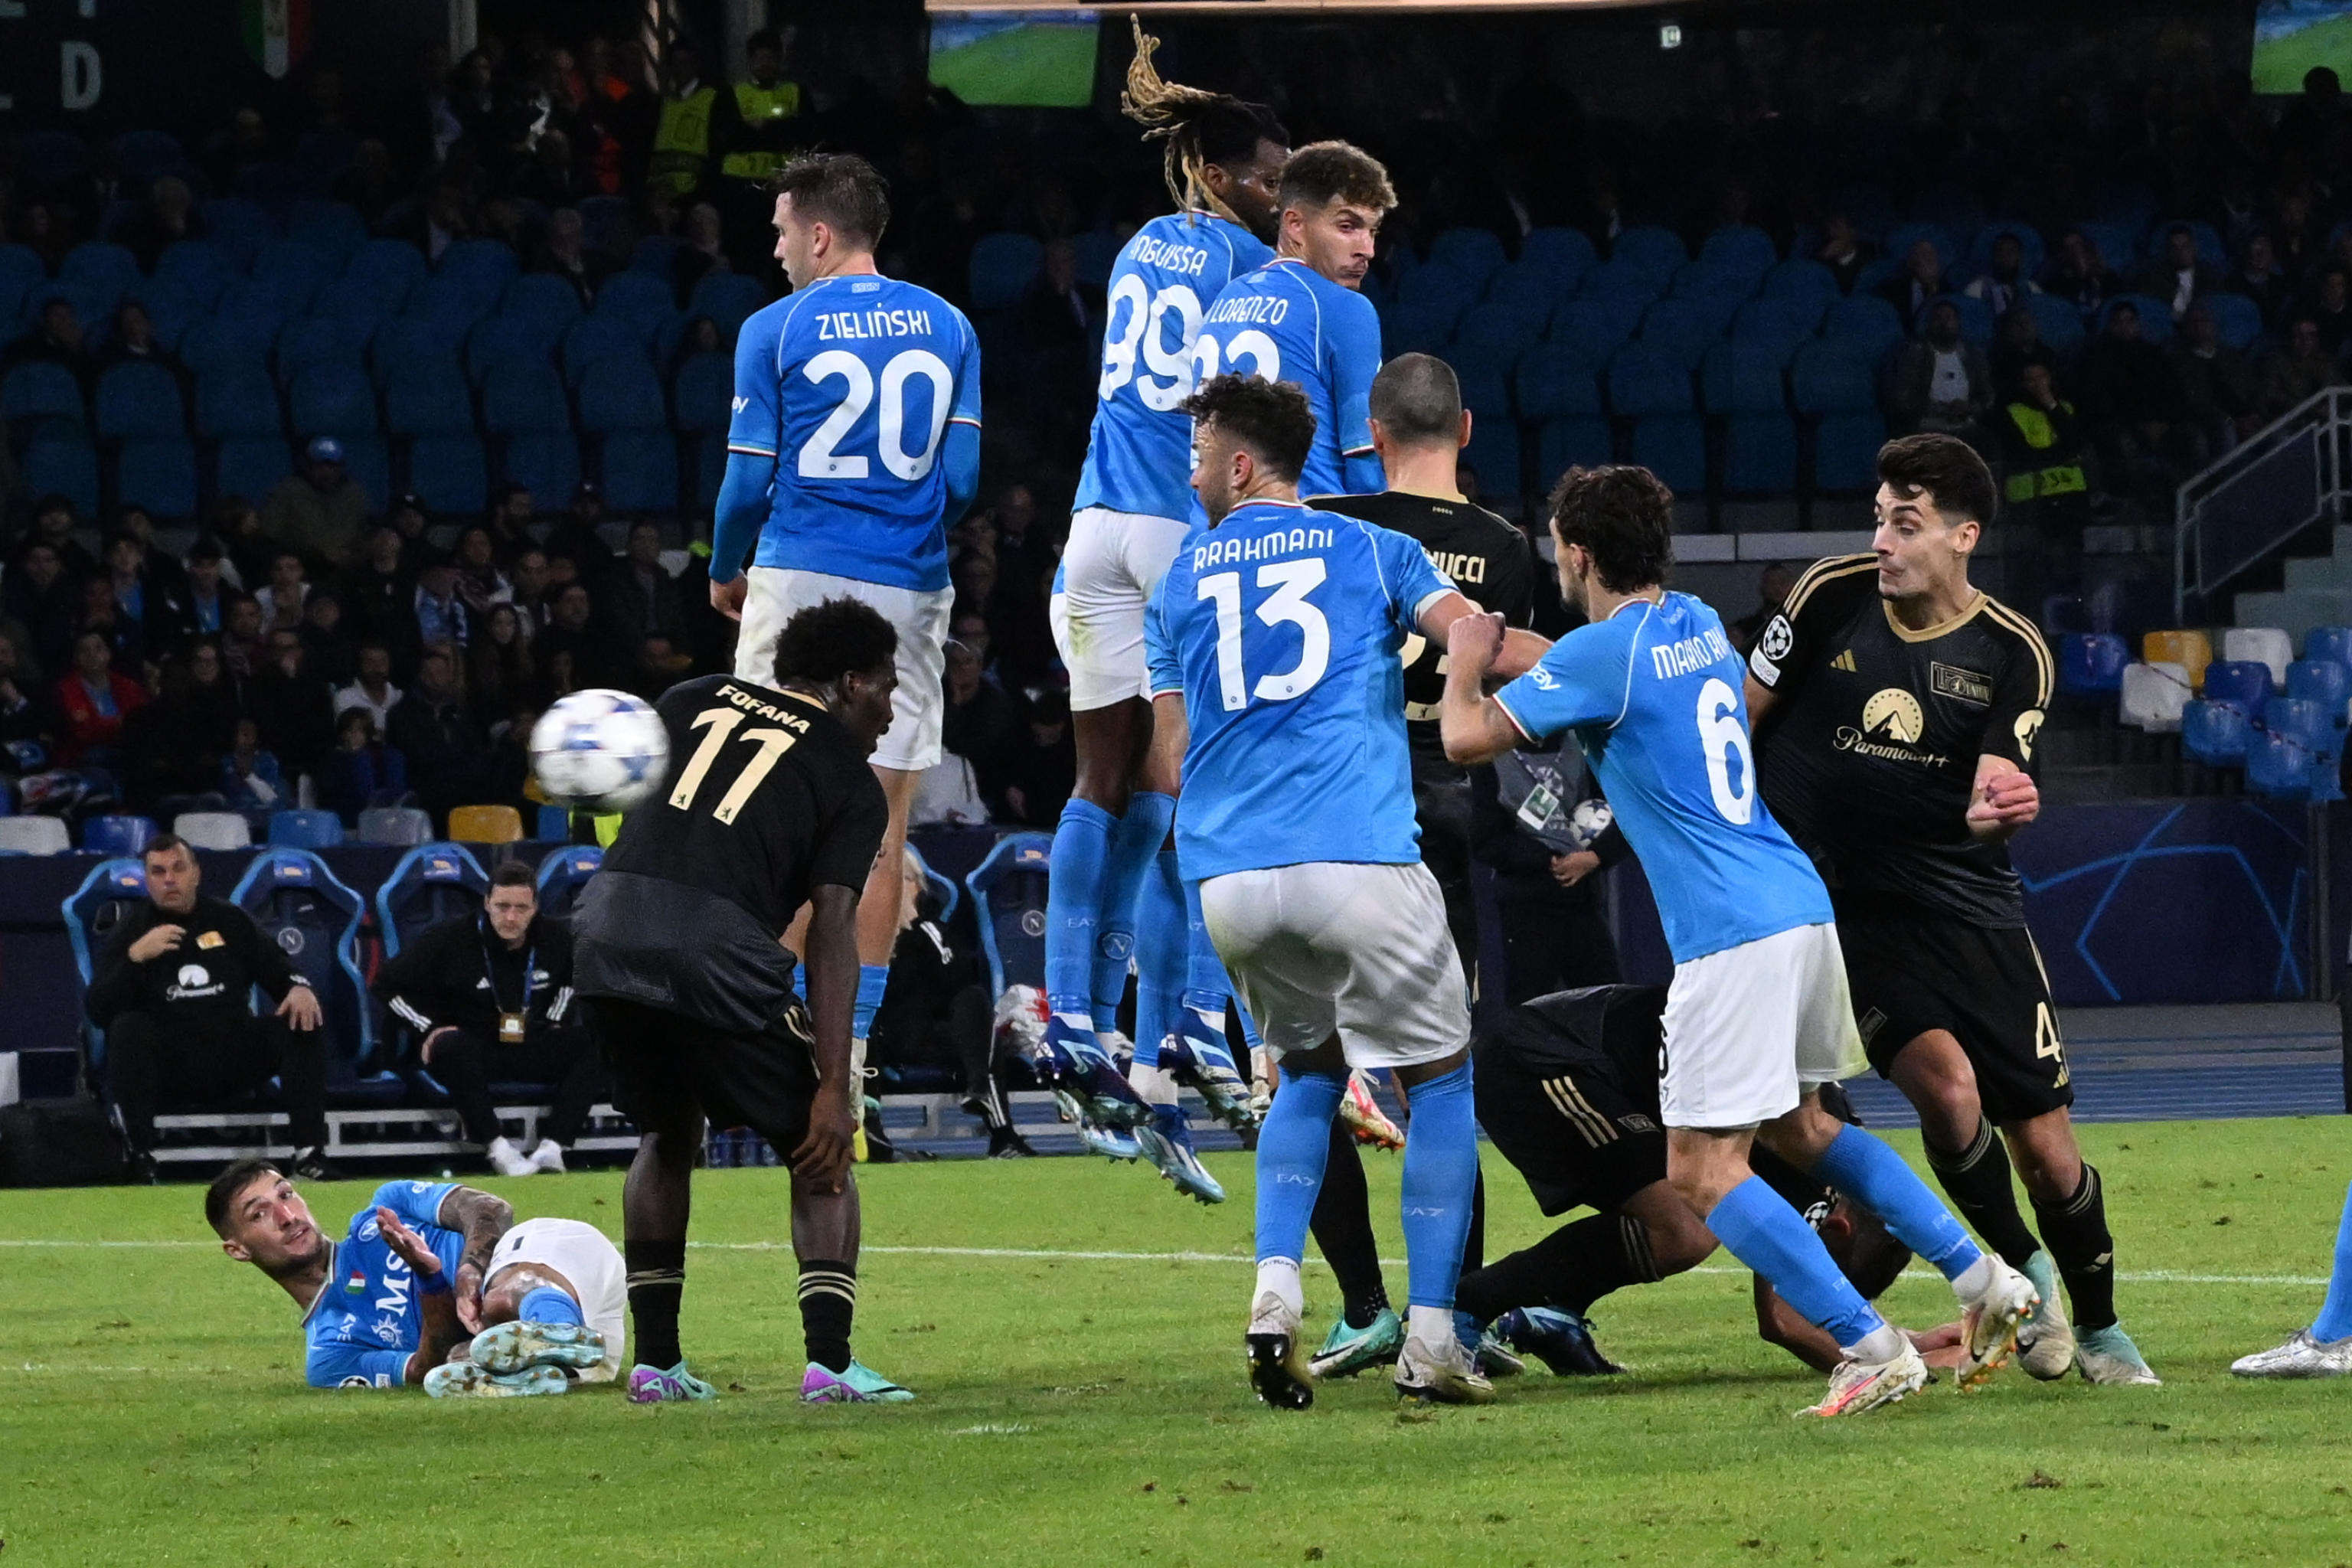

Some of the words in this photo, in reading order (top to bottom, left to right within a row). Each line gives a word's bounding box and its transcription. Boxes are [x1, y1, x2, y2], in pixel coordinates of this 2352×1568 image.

[1099, 273, 1204, 412] 99
[1210, 296, 1289, 325] LORENZO
[798, 349, 954, 481] 20
[1193, 528, 1334, 573] RRAHMANI
[1197, 557, 1331, 712] 13
[1651, 635, 1713, 680] MARIO
[715, 684, 812, 735] FOFANA
[1696, 678, 1755, 825] 6
[668, 707, 797, 826] 11
[2035, 1001, 2063, 1063] 4
[375, 1234, 421, 1318] MS
